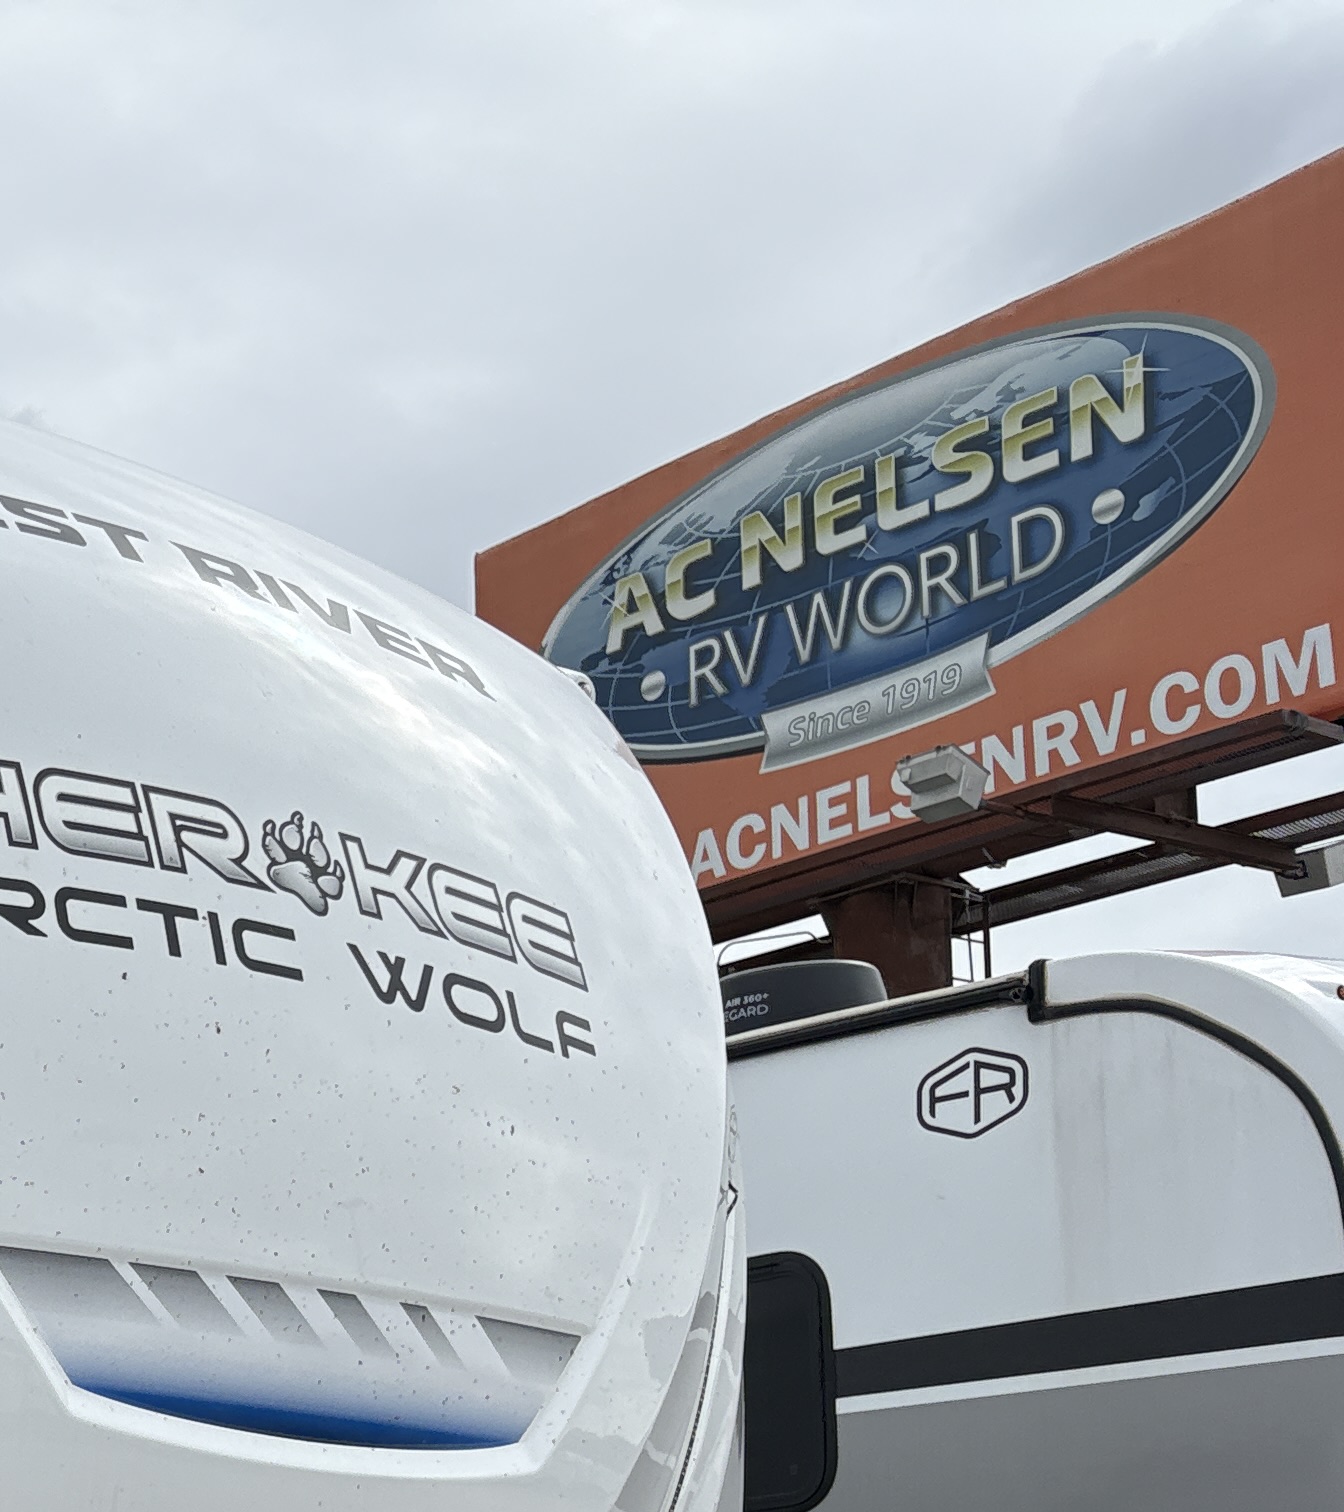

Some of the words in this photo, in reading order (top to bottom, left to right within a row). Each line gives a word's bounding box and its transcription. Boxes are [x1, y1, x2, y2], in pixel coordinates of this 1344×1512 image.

[605, 538, 717, 655] AC
[740, 353, 1146, 592] NELSEN
[169, 540, 496, 703] RIVER
[687, 612, 769, 708] RV
[785, 503, 1067, 666] WORLD
[689, 622, 1339, 884] ACNELNRV.COM
[786, 698, 872, 750] Since
[882, 661, 965, 717] 1919
[346, 942, 597, 1060] WOLF
[724, 996, 742, 1010] AIR
[742, 992, 771, 1005] 360+
